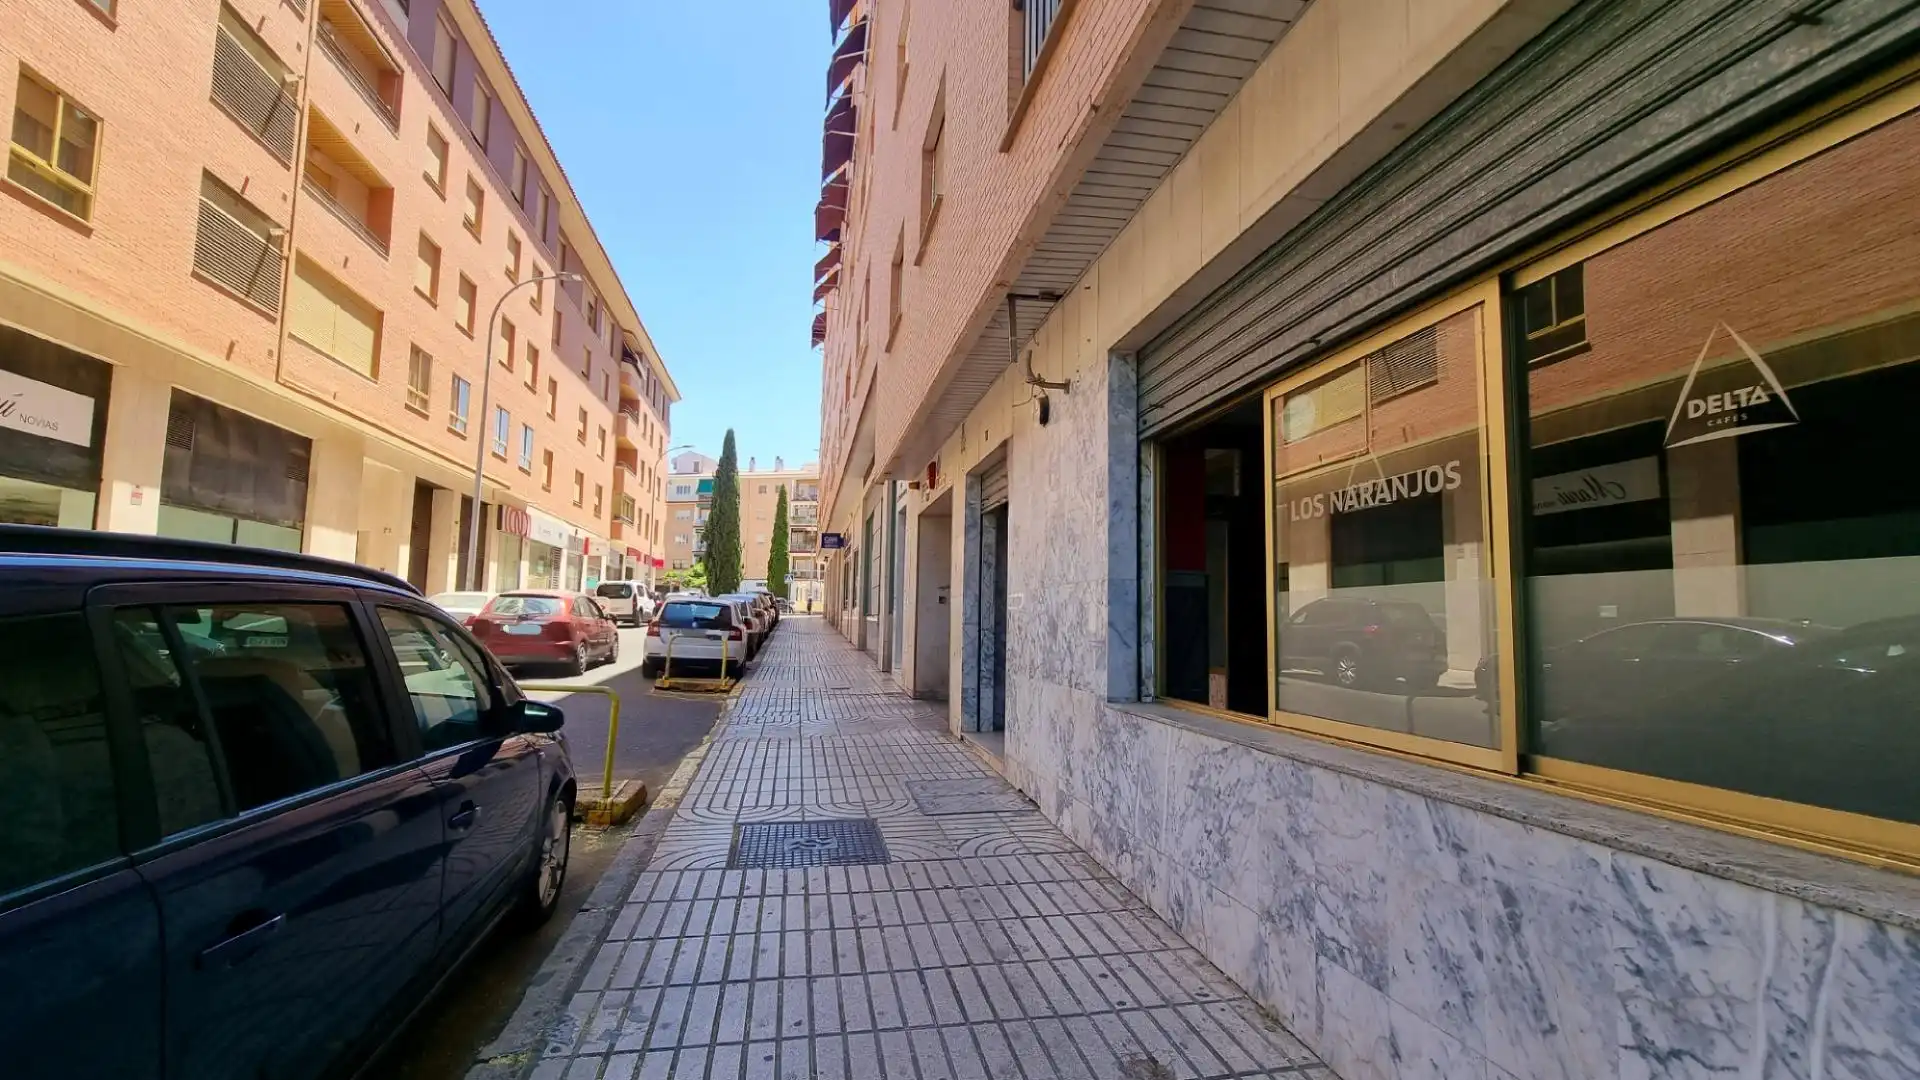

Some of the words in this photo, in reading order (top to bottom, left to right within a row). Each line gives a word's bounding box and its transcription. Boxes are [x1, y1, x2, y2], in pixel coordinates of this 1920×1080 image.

[1687, 385, 1770, 419] DELTA
[19, 413, 59, 431] NOVIAS
[1291, 493, 1324, 522] LOS
[1329, 460, 1461, 515] NARANJOS
